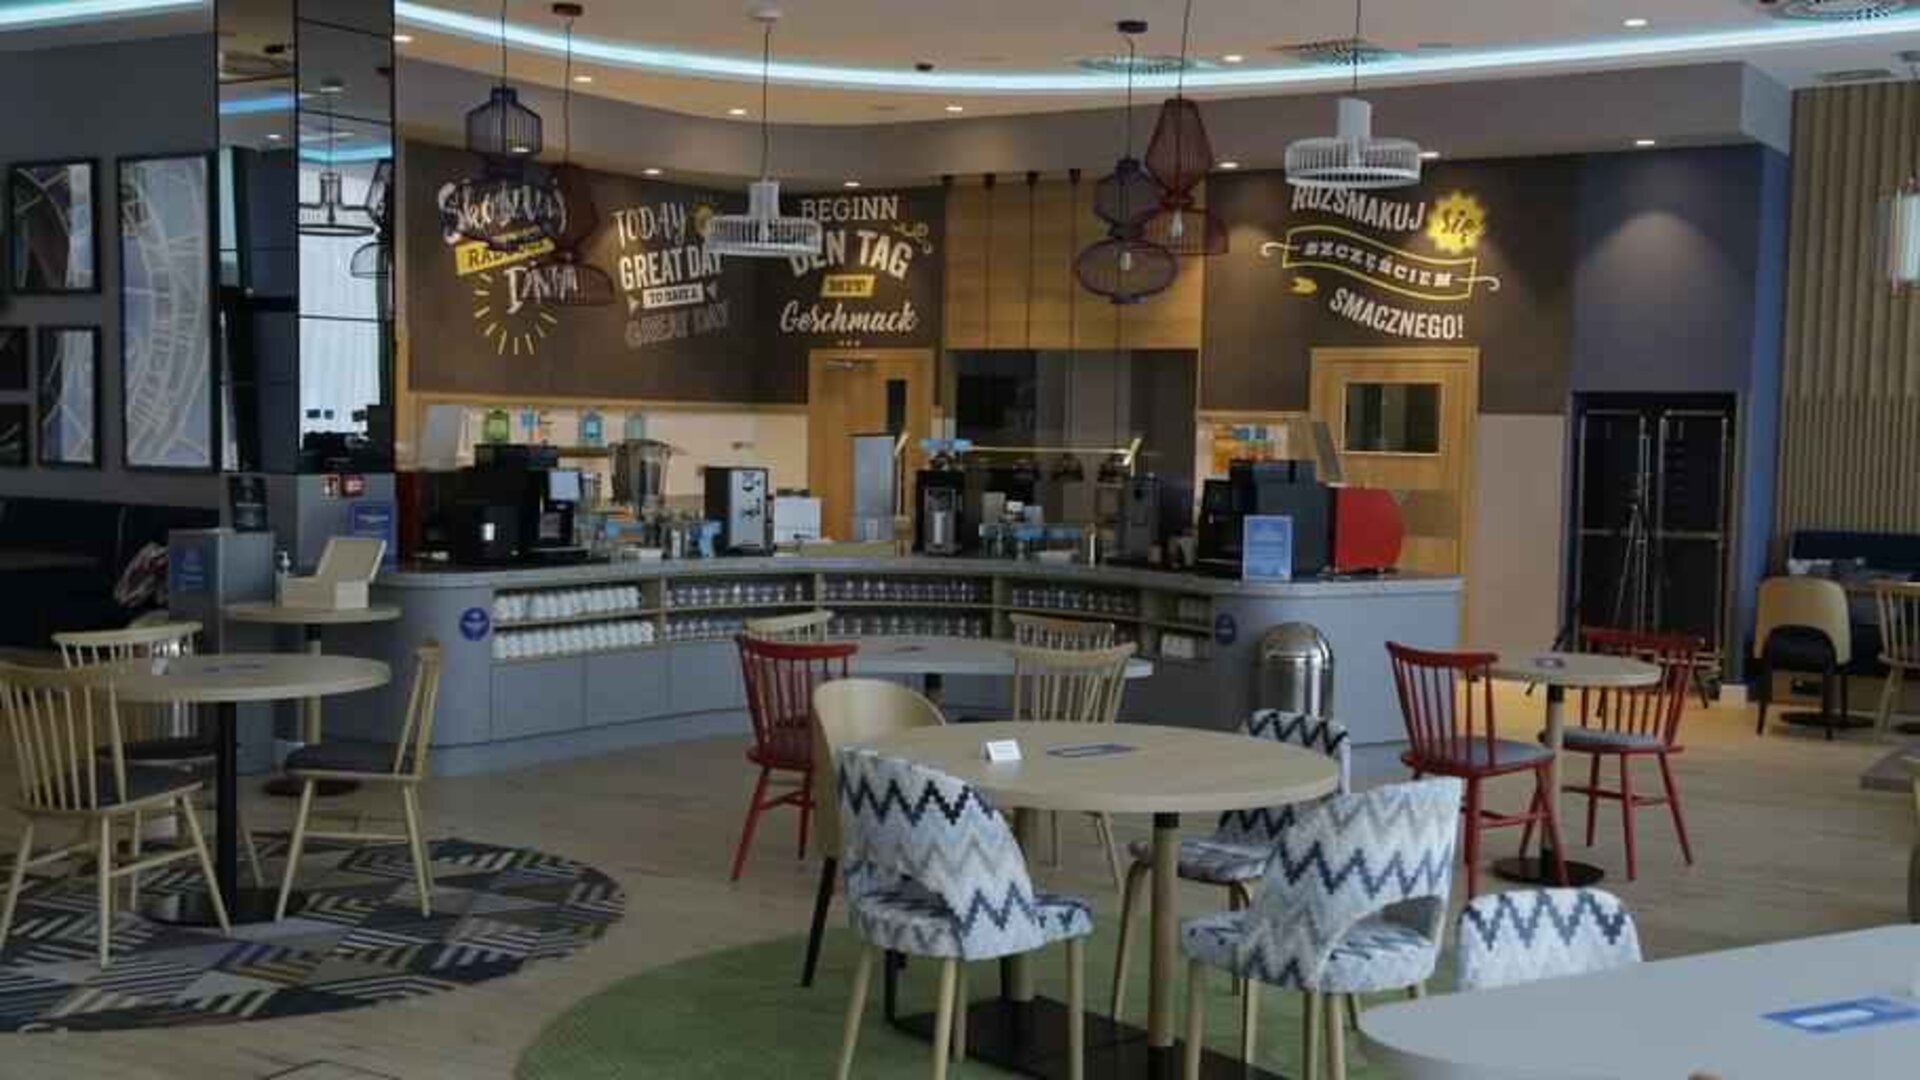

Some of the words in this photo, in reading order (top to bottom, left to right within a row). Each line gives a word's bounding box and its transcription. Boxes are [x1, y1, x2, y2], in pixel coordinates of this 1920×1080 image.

[611, 202, 687, 249] TODAY
[803, 196, 898, 222] BEGINN
[1290, 186, 1426, 231] ROZSMAKUJ
[619, 247, 683, 290] GREAT
[857, 230, 913, 281] TAG
[780, 300, 919, 333] Geschmack
[1330, 287, 1464, 339] SMACZNEGO!
